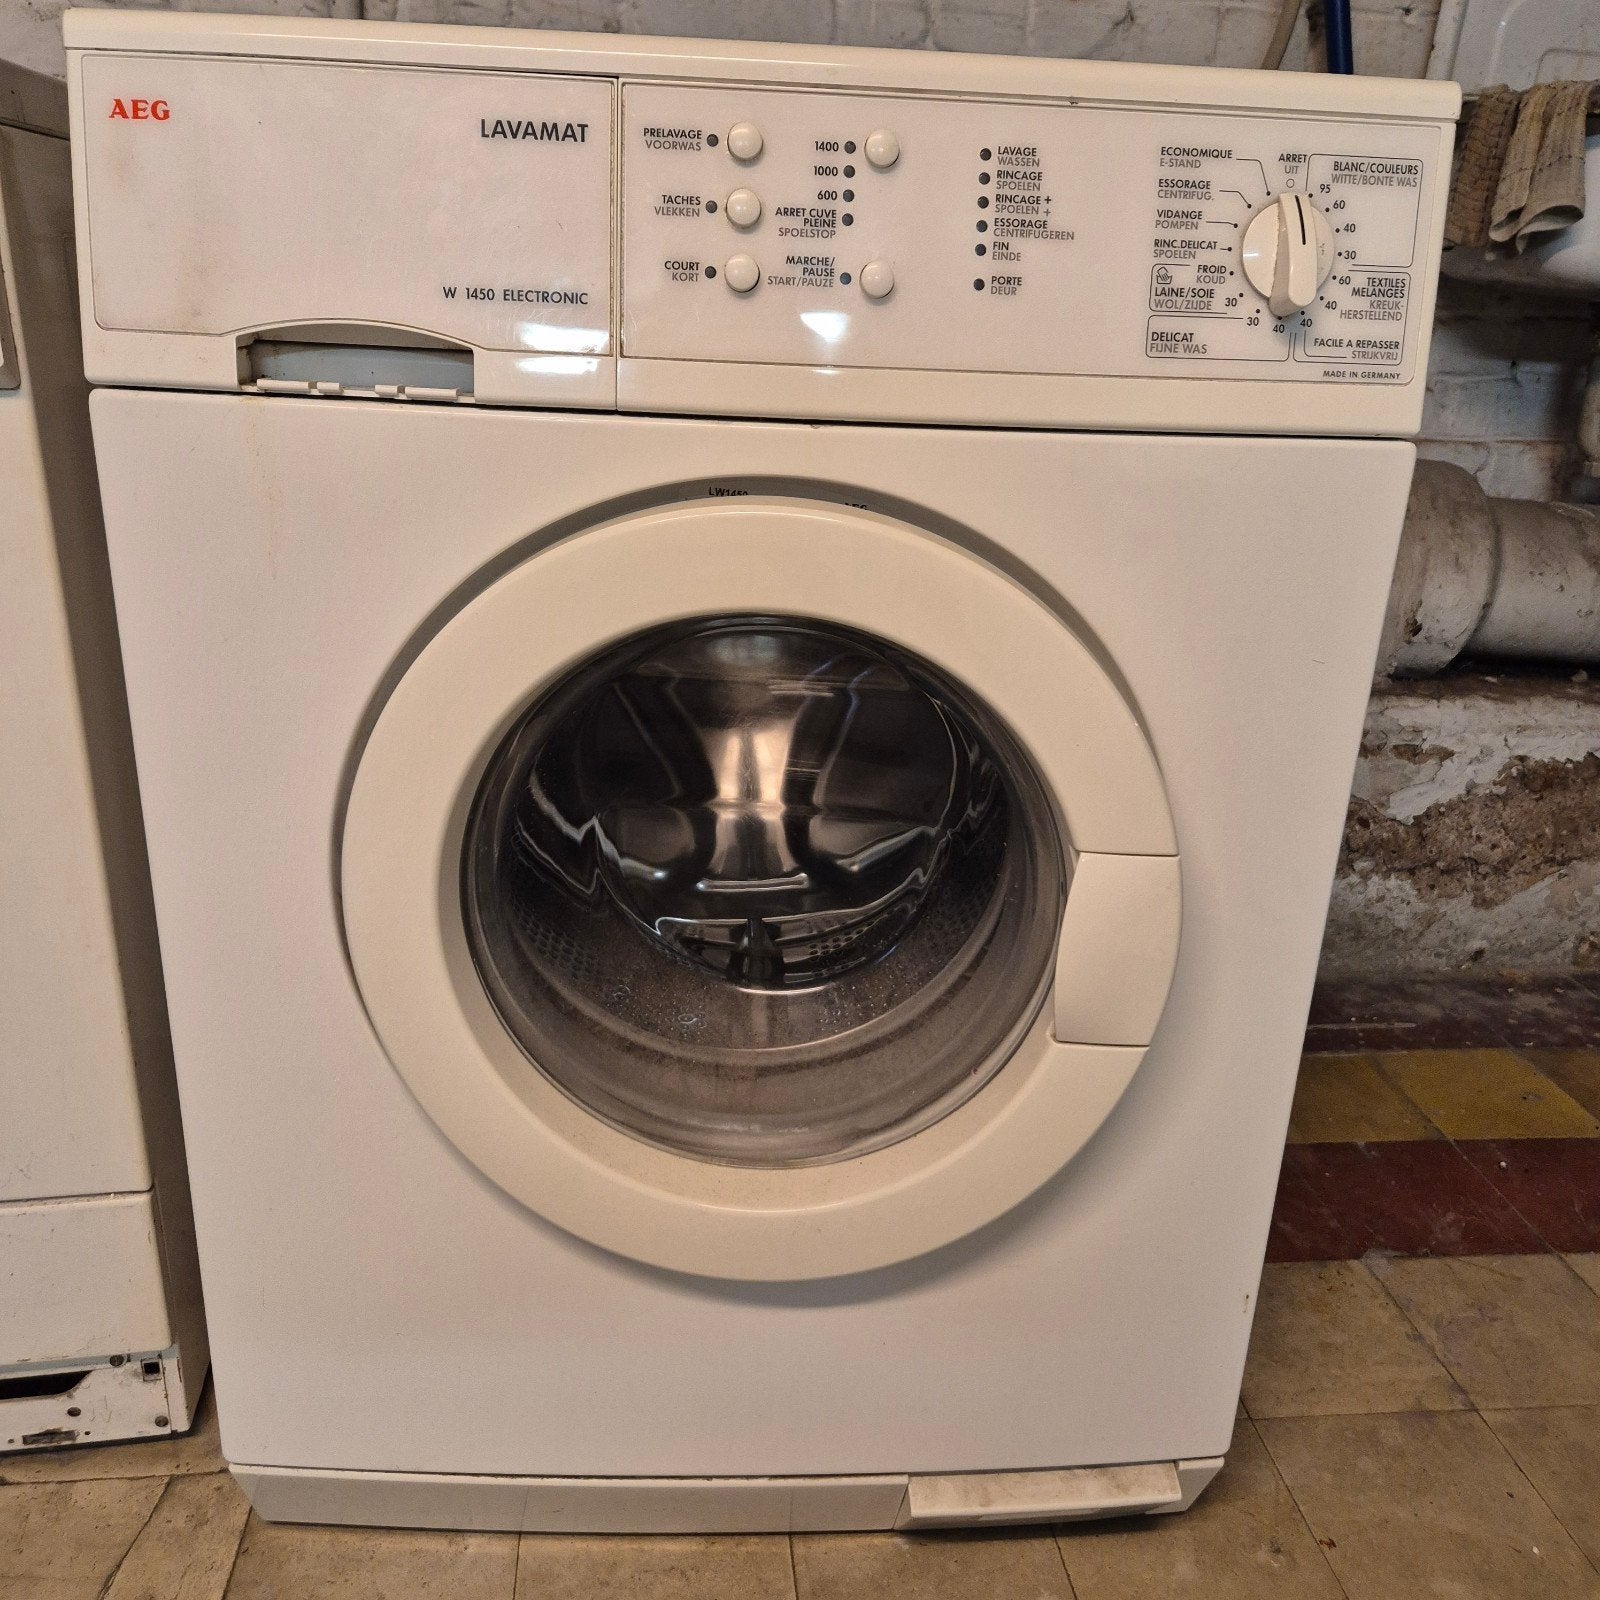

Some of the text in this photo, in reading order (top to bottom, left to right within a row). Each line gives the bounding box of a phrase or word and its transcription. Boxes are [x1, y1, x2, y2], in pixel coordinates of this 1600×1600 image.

[109, 99, 170, 120] AEG
[481, 119, 588, 142] LAVAMAT
[644, 128, 702, 139] PRELAVAGE
[645, 140, 701, 151] VOORWAS
[815, 141, 839, 152] 1400
[998, 146, 1037, 157] LAVAGE
[1161, 146, 1232, 159] ECONOMIQUE
[998, 157, 1040, 167] WASSEN
[1160, 158, 1201, 168] E-STAND
[1278, 153, 1308, 163] ARRET
[814, 165, 838, 176] 1000
[1284, 165, 1299, 174] UIT
[1334, 161, 1418, 175] BLANC/COULEURS
[997, 170, 1043, 181] RINCAGE
[1331, 174, 1417, 187] WITTE/BONTE WAS
[996, 181, 1040, 191] SPOELEN
[1158, 179, 1211, 190] ESSORAGE
[1320, 184, 1330, 193] 95
[662, 195, 700, 205] TACHES
[817, 190, 837, 200] 600
[995, 194, 1041, 205] RINCAGE
[995, 205, 1039, 215] SPOELEN
[1333, 200, 1345, 210] 60
[654, 206, 700, 217] VLEKKEN
[775, 207, 837, 218] ARRET CUVE
[1157, 209, 1202, 220] VIDANGE
[804, 218, 836, 228] PLEINE
[994, 218, 1048, 229] ESSORAGE
[1155, 220, 1198, 230] POMPEN
[779, 227, 836, 238] SPOELSTOP
[1344, 224, 1356, 233] 40
[994, 228, 1074, 240] CENTRIFUGEREN
[993, 242, 1009, 250] FIN
[992, 252, 1021, 261] EINDE
[1153, 250, 1196, 259] SPOELEN
[1344, 251, 1356, 260] 30
[665, 261, 700, 271] COURT
[786, 256, 835, 267] MARCHE/
[803, 267, 834, 277] PAUSE
[1198, 265, 1226, 274] FROID
[672, 273, 699, 282] KORT
[768, 276, 834, 287] START/PAUZE
[992, 276, 1022, 286] PORTE
[1196, 275, 1226, 284] KOUD
[1339, 276, 1351, 284] 60
[1367, 278, 1406, 288] TEXTILES
[991, 286, 1017, 295] DEUR
[1155, 287, 1214, 298] LAINE/SOIE
[1351, 287, 1404, 298] MELANGES
[443, 287, 588, 305] W 1450 ELECTRONIC
[1154, 298, 1212, 310] WOL/ZIJDE
[1225, 298, 1237, 307] 30
[1325, 301, 1337, 310] 40
[1370, 300, 1404, 309] KREUK-
[1340, 310, 1402, 321] HERSTELLEND
[1247, 317, 1259, 326] 30
[1300, 319, 1312, 327] 40
[1273, 324, 1284, 333] 40
[1152, 332, 1194, 342] DELICAT
[1314, 338, 1400, 349] FACILE A REPASSER
[1183, 344, 1207, 354] WAS
[1352, 350, 1398, 360] STRIJKVRIJ
